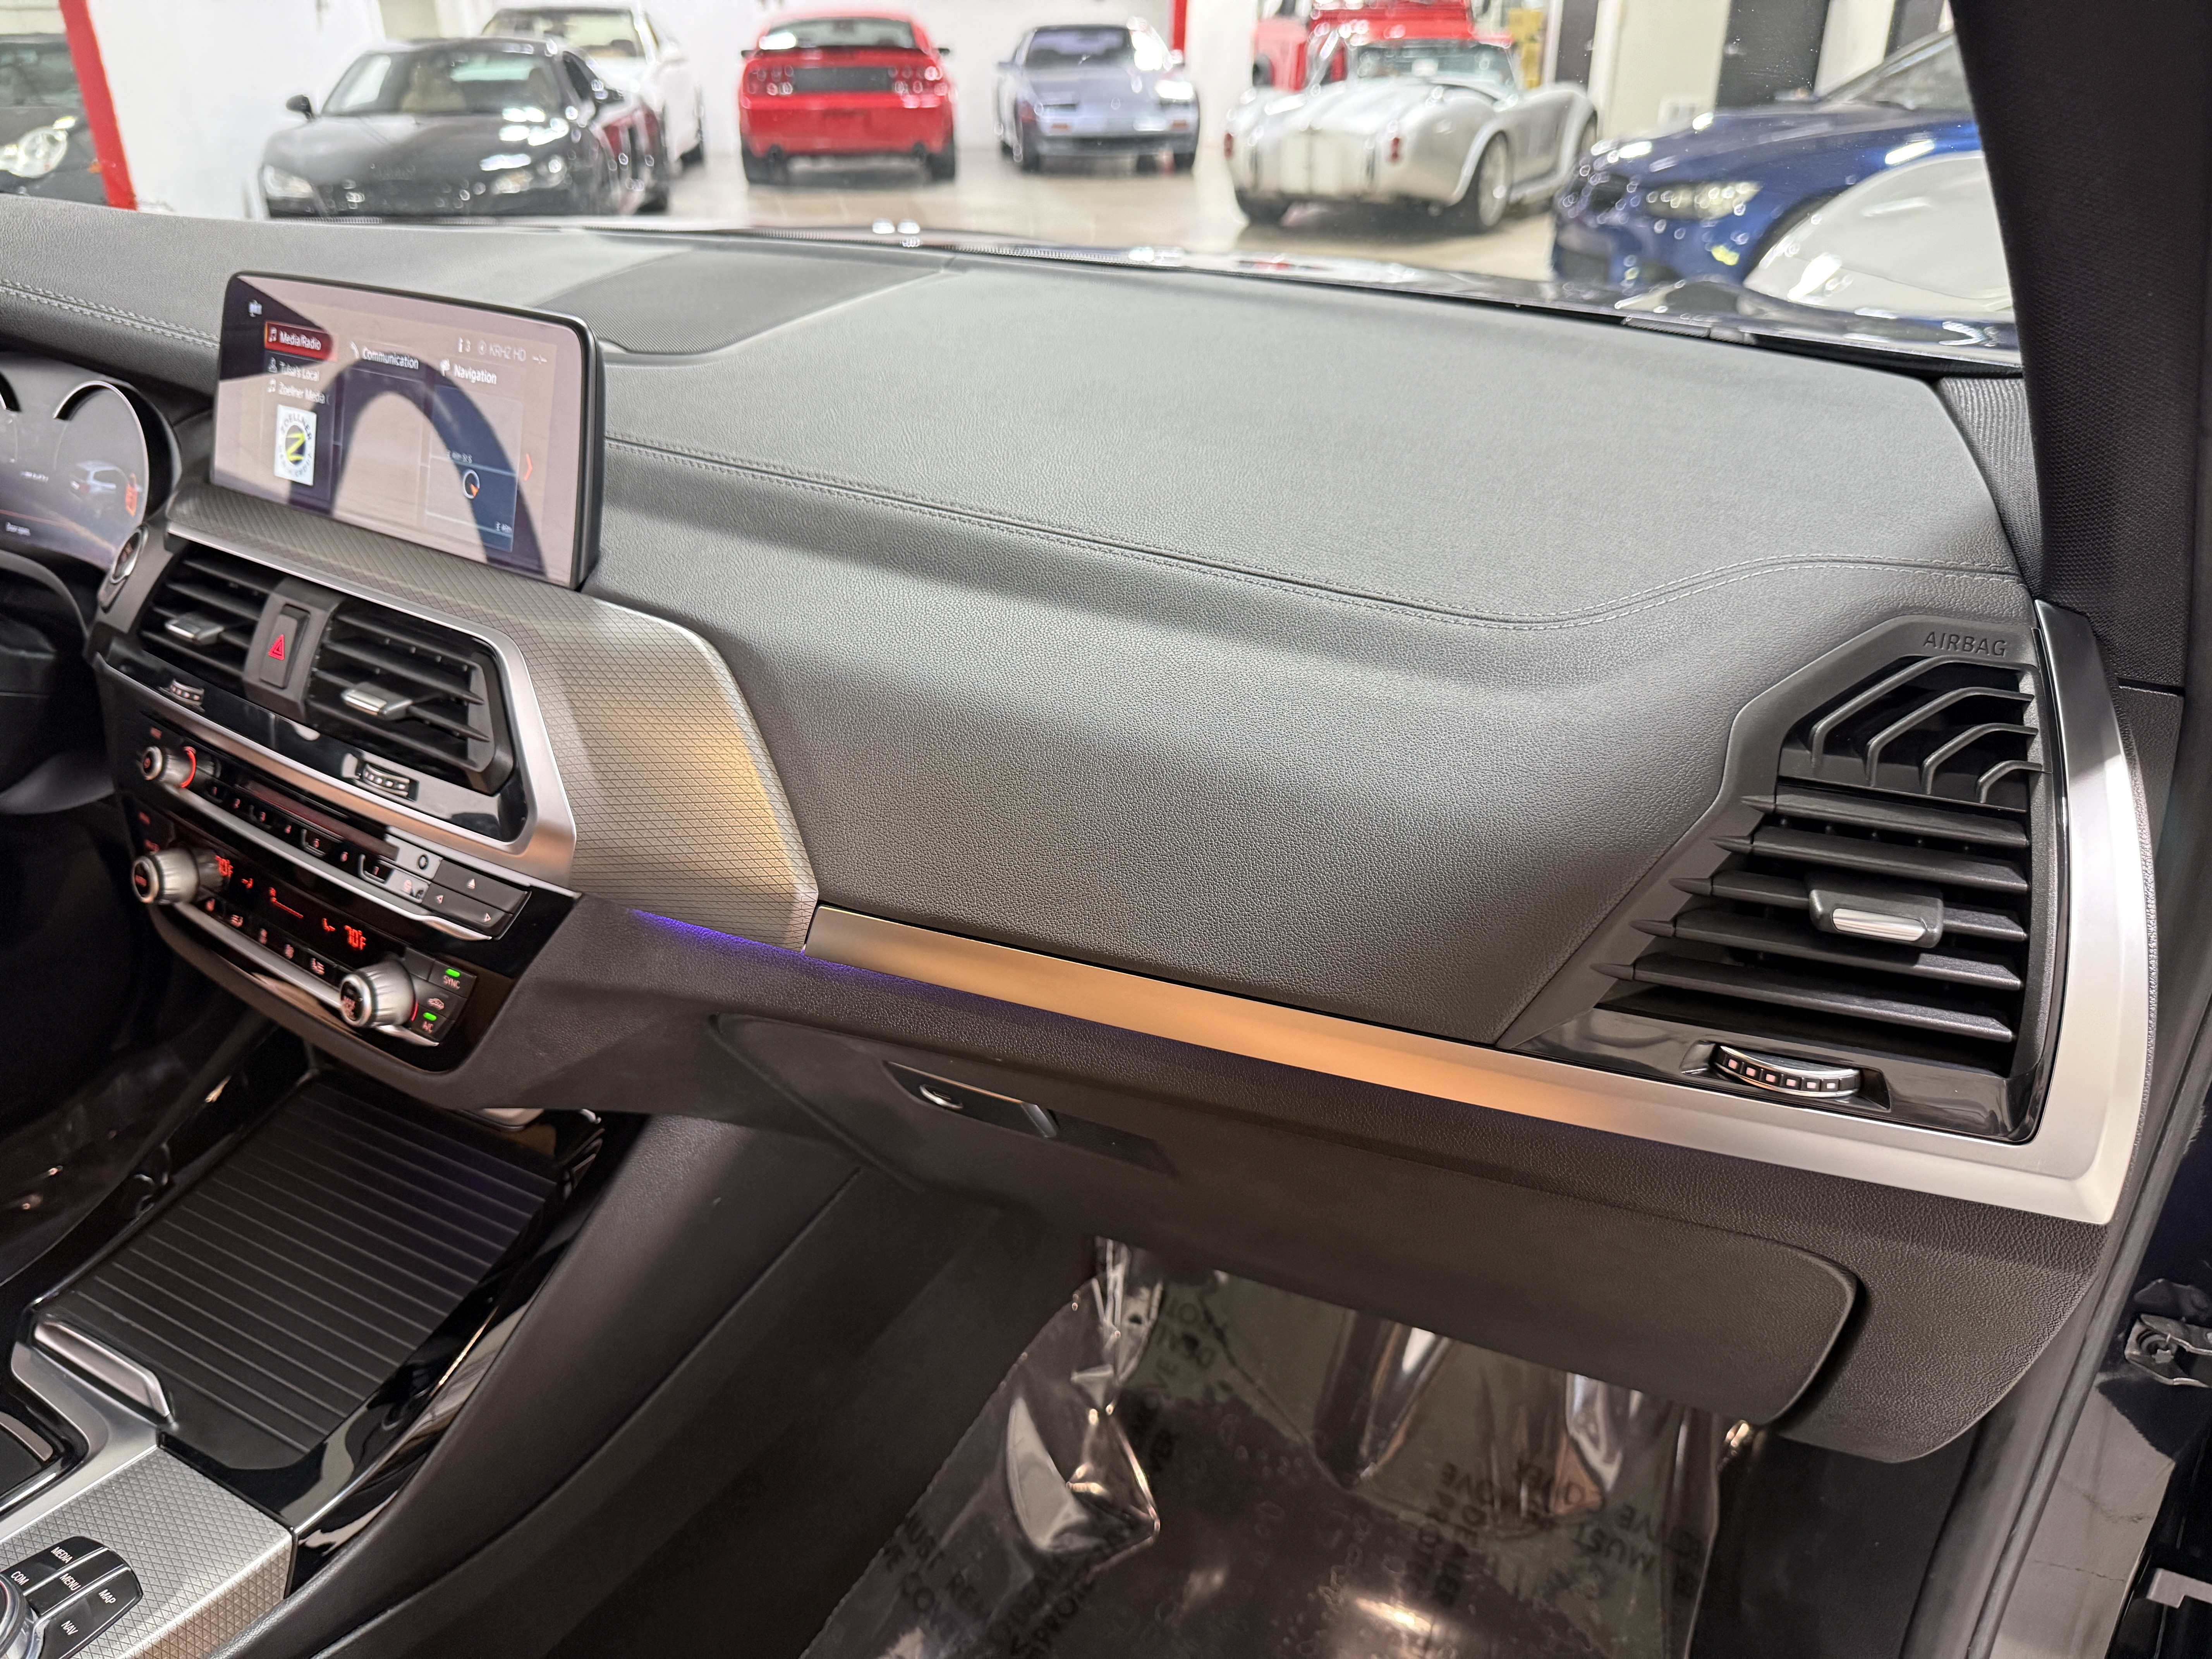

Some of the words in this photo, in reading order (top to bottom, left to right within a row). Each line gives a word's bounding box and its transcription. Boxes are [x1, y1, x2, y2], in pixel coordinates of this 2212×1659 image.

[362, 346, 419, 369] Communication
[453, 363, 497, 384] Navigation
[1923, 631, 2007, 657] AIRBAG
[443, 975, 461, 990] SYNC
[51, 1546, 74, 1564] MEDIA
[10, 1571, 29, 1586] COM
[59, 1573, 82, 1592] MENU
[98, 1589, 117, 1605] MAP
[61, 1620, 79, 1635] NAV
